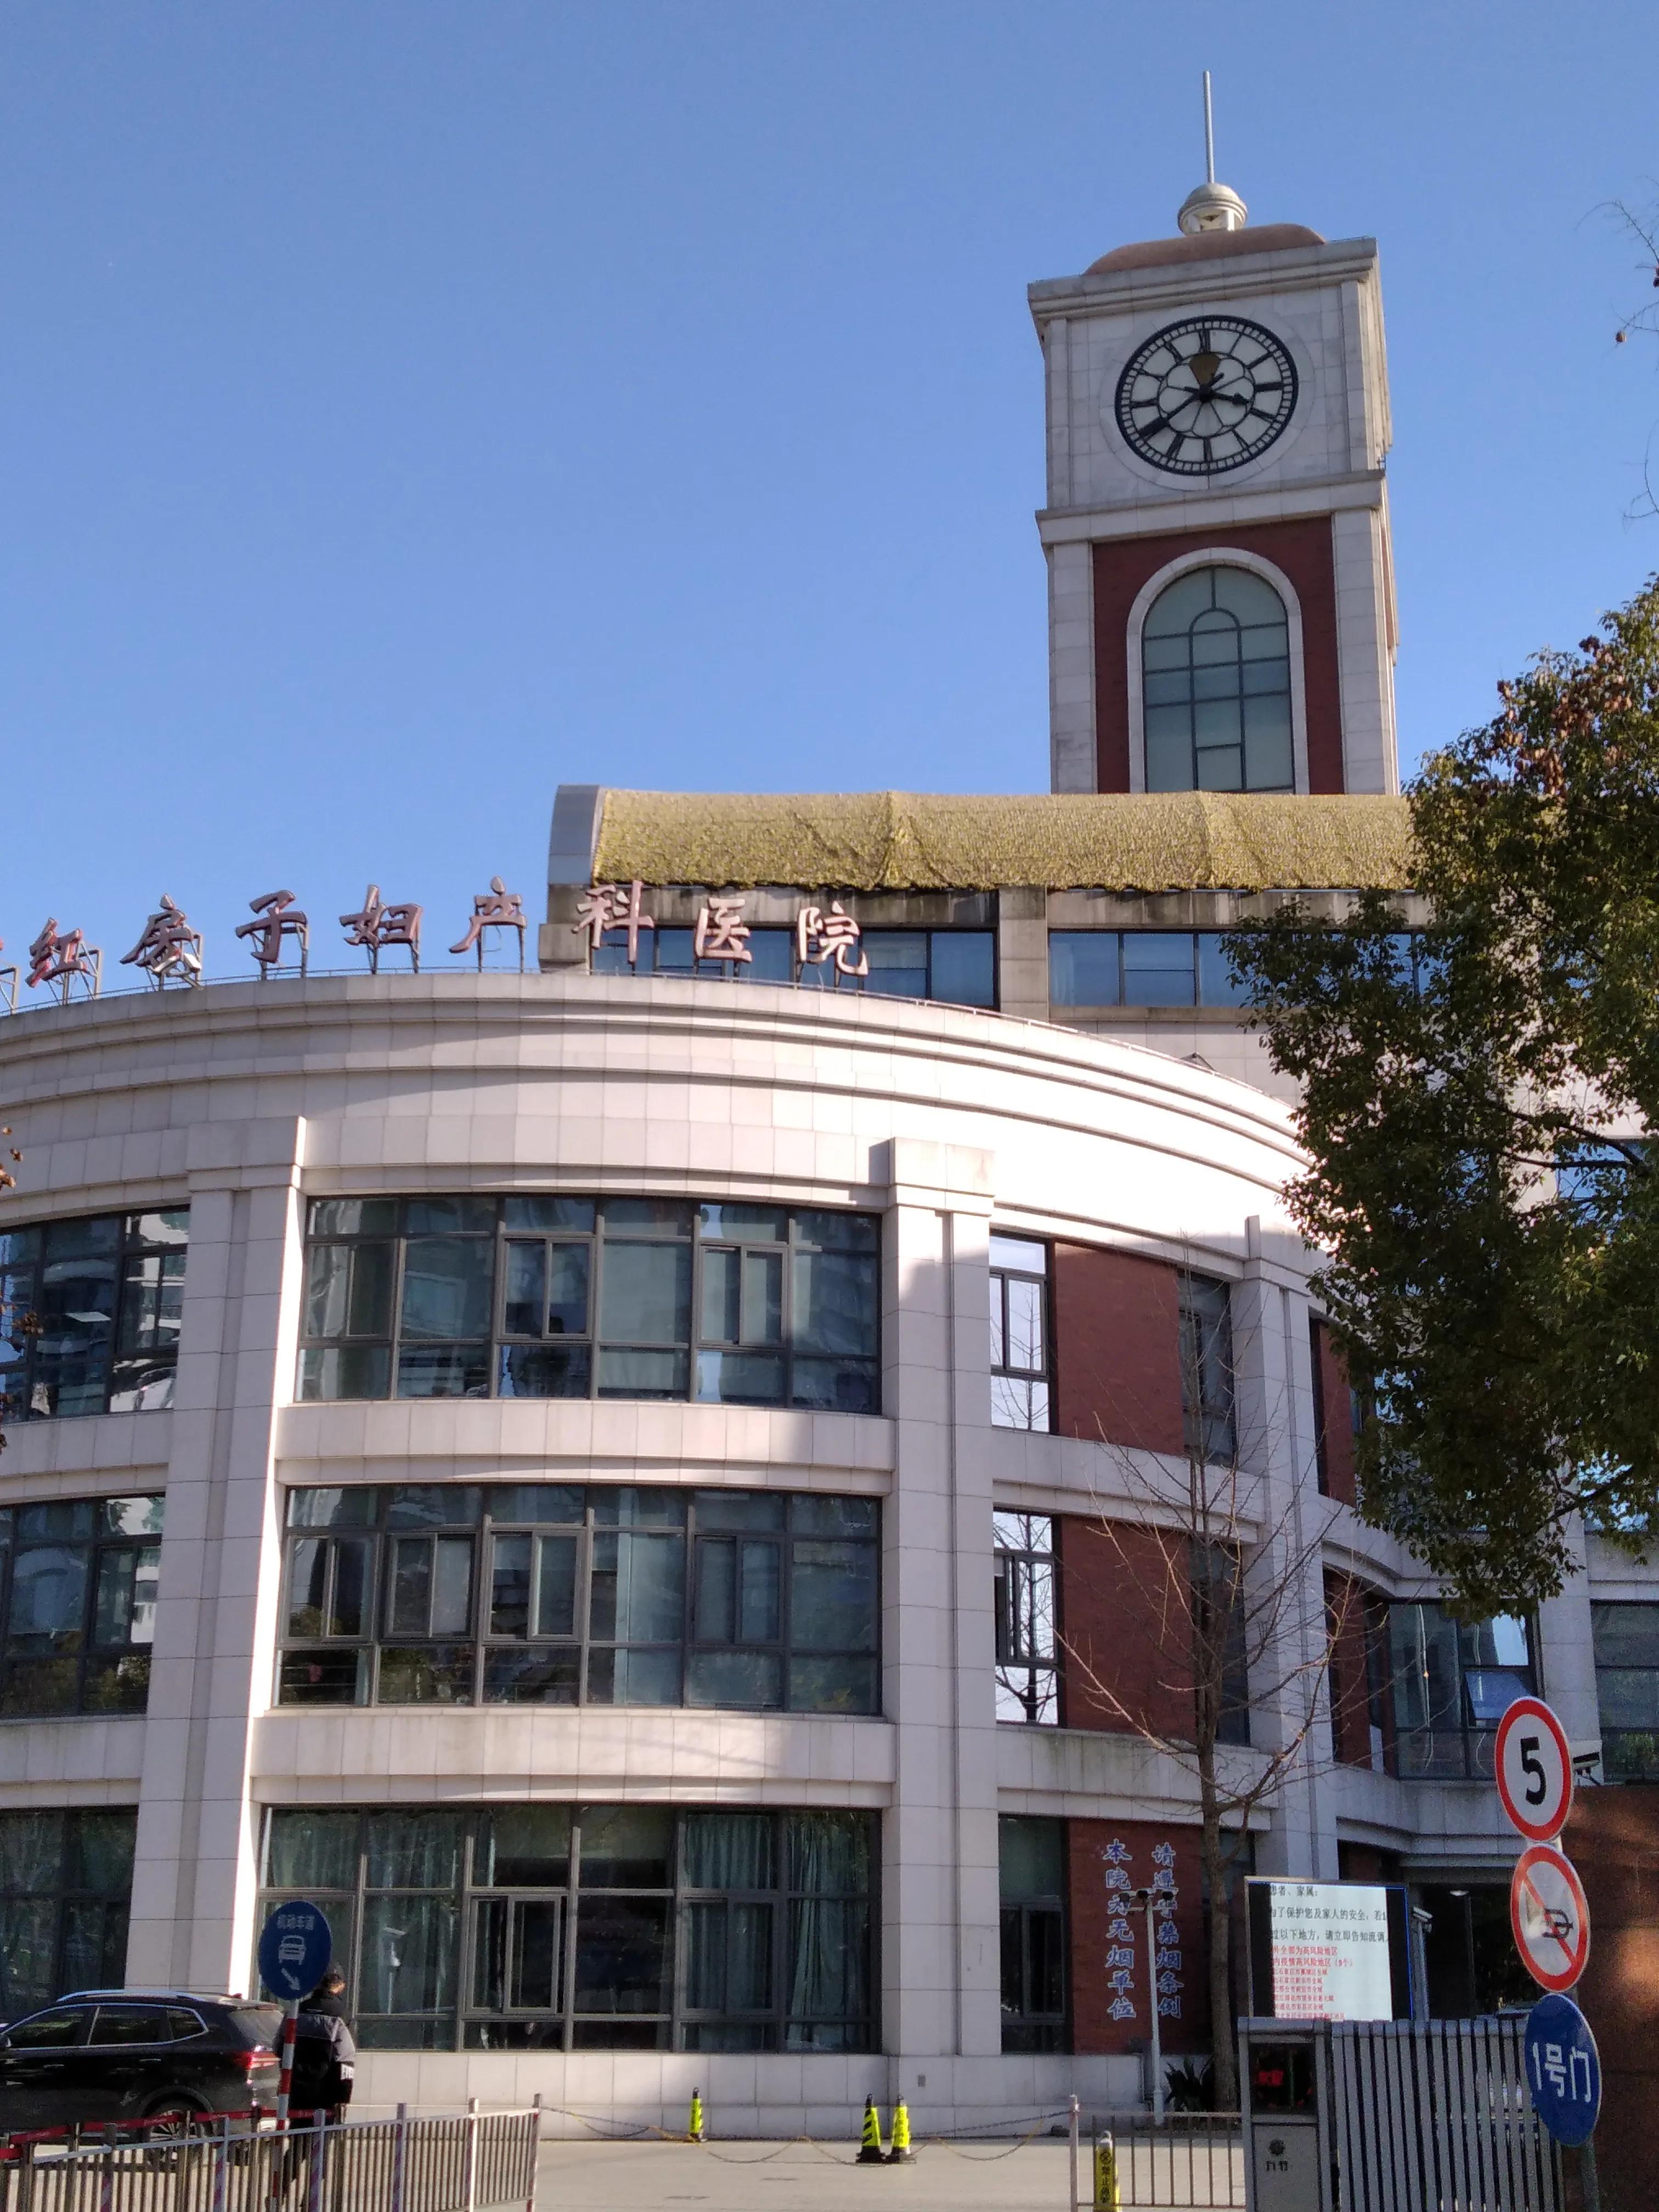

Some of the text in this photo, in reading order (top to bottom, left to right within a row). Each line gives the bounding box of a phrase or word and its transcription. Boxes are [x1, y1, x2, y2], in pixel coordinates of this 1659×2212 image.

[1520, 1736, 1547, 1805] 5
[1103, 1838, 1137, 2021] 本院为无烟单位
[1531, 2041, 1592, 2103] 1号门
